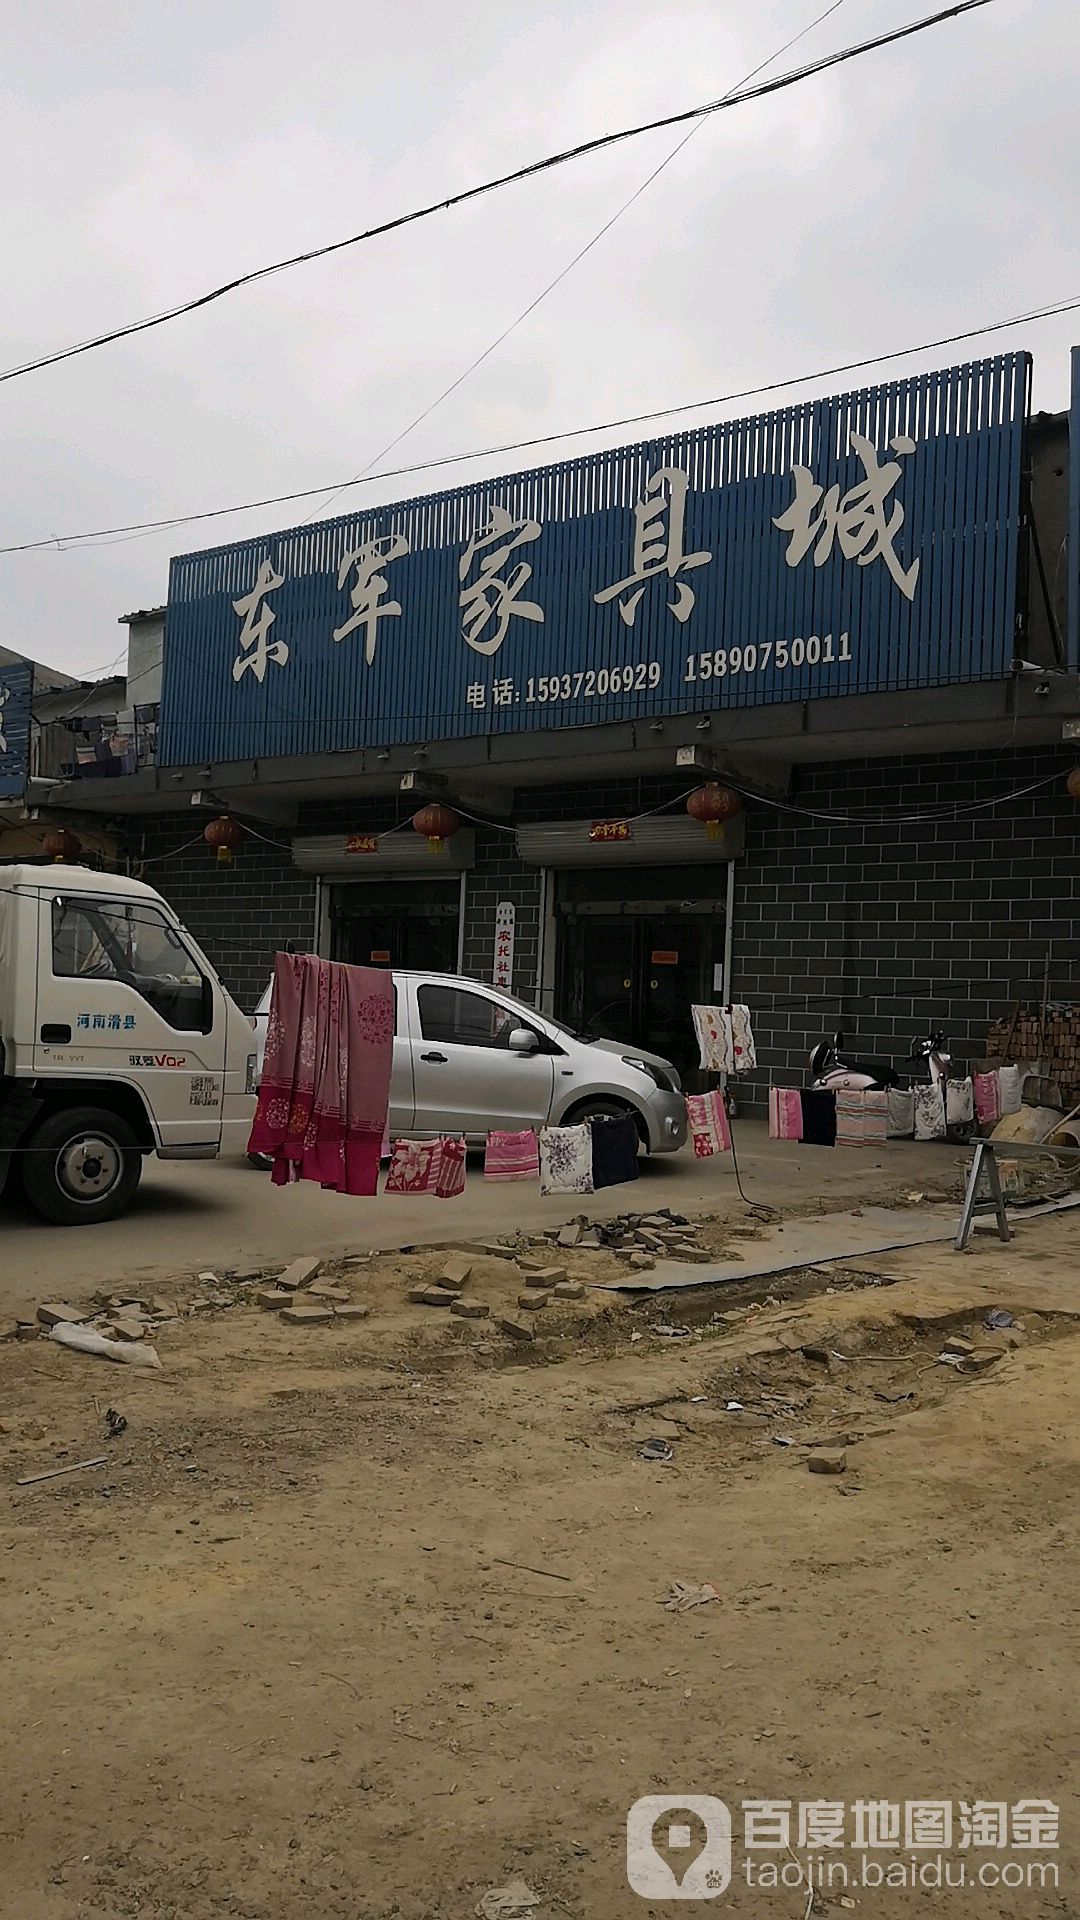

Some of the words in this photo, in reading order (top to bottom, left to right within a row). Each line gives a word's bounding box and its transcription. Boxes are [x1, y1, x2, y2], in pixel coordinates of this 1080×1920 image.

[232, 431, 920, 684] 东军家具城
[683, 631, 852, 683] 15890750011
[76, 1013, 137, 1030] 河南滑县
